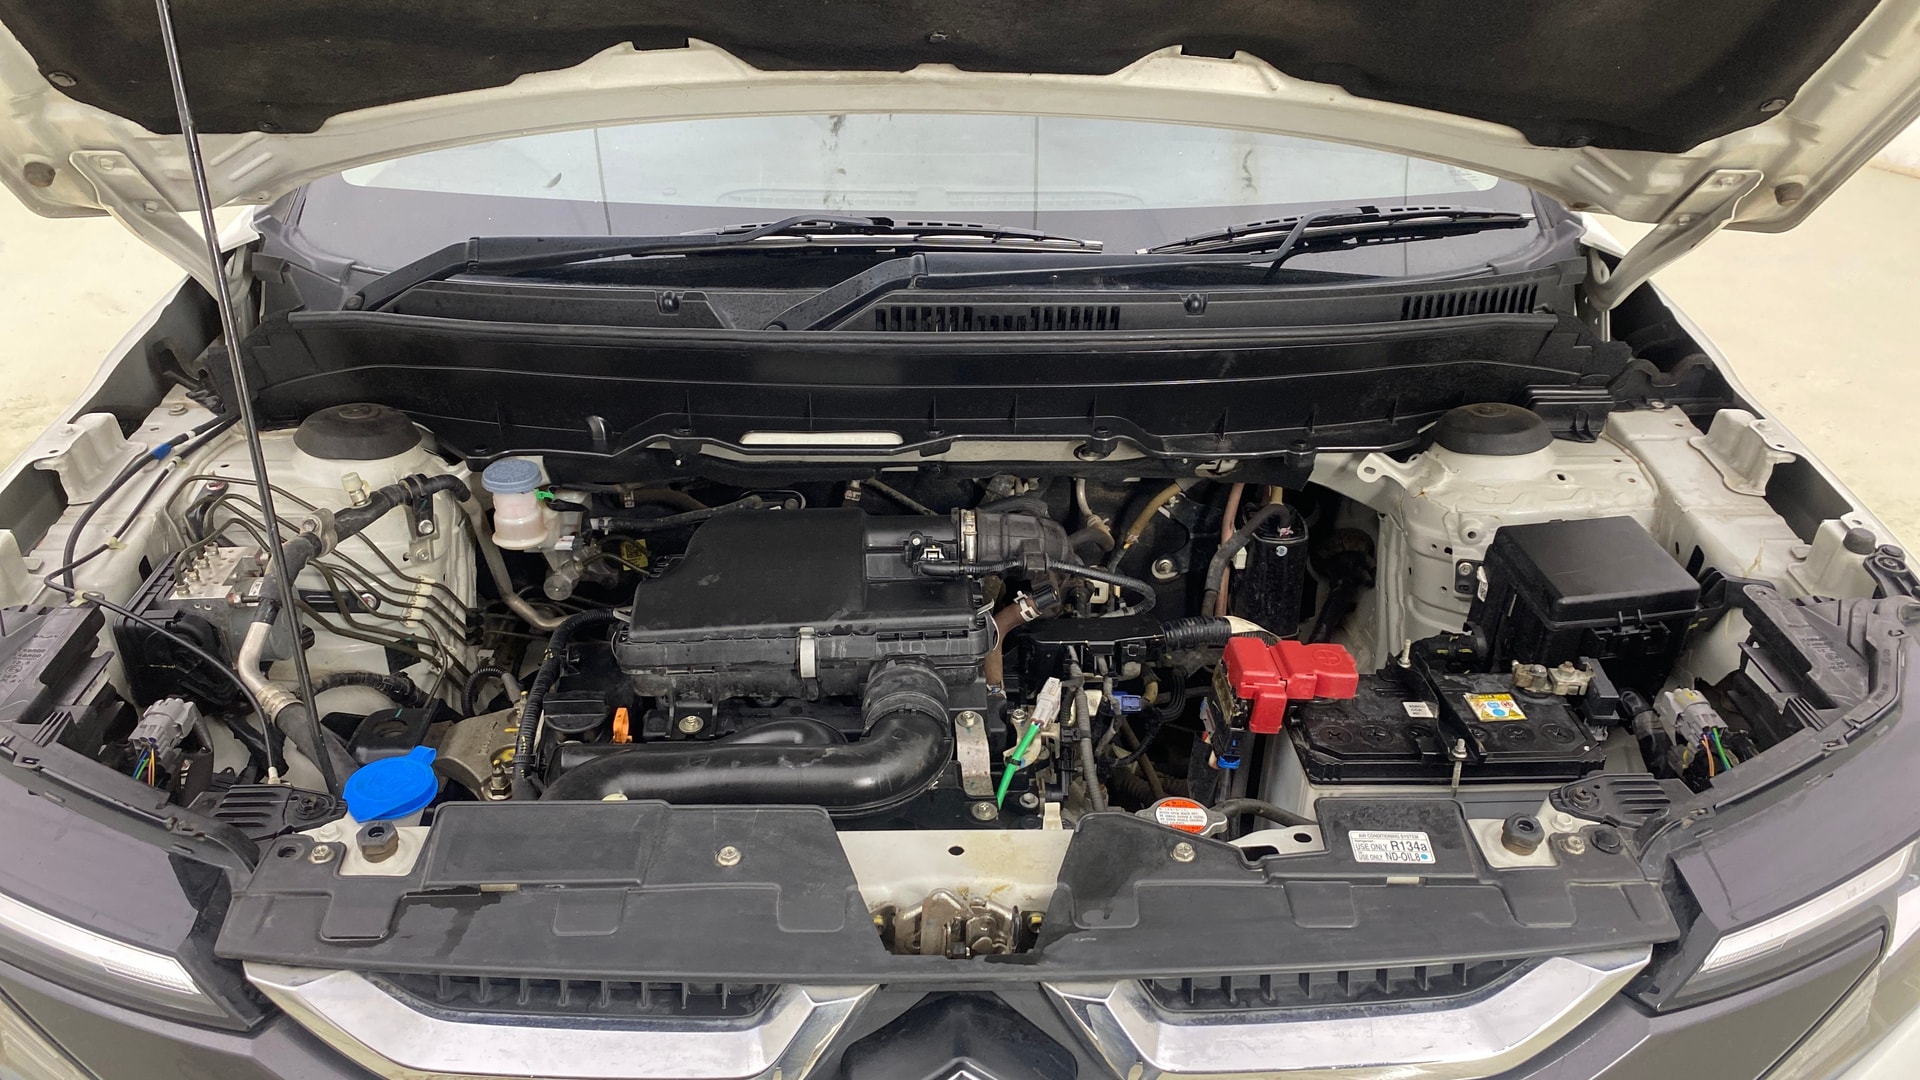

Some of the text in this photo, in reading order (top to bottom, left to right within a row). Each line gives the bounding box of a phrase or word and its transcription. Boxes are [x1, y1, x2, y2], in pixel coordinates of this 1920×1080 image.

[1370, 843, 1388, 851] ONLY
[1390, 841, 1428, 852] R134a
[1385, 852, 1421, 862] ND-OIL8
